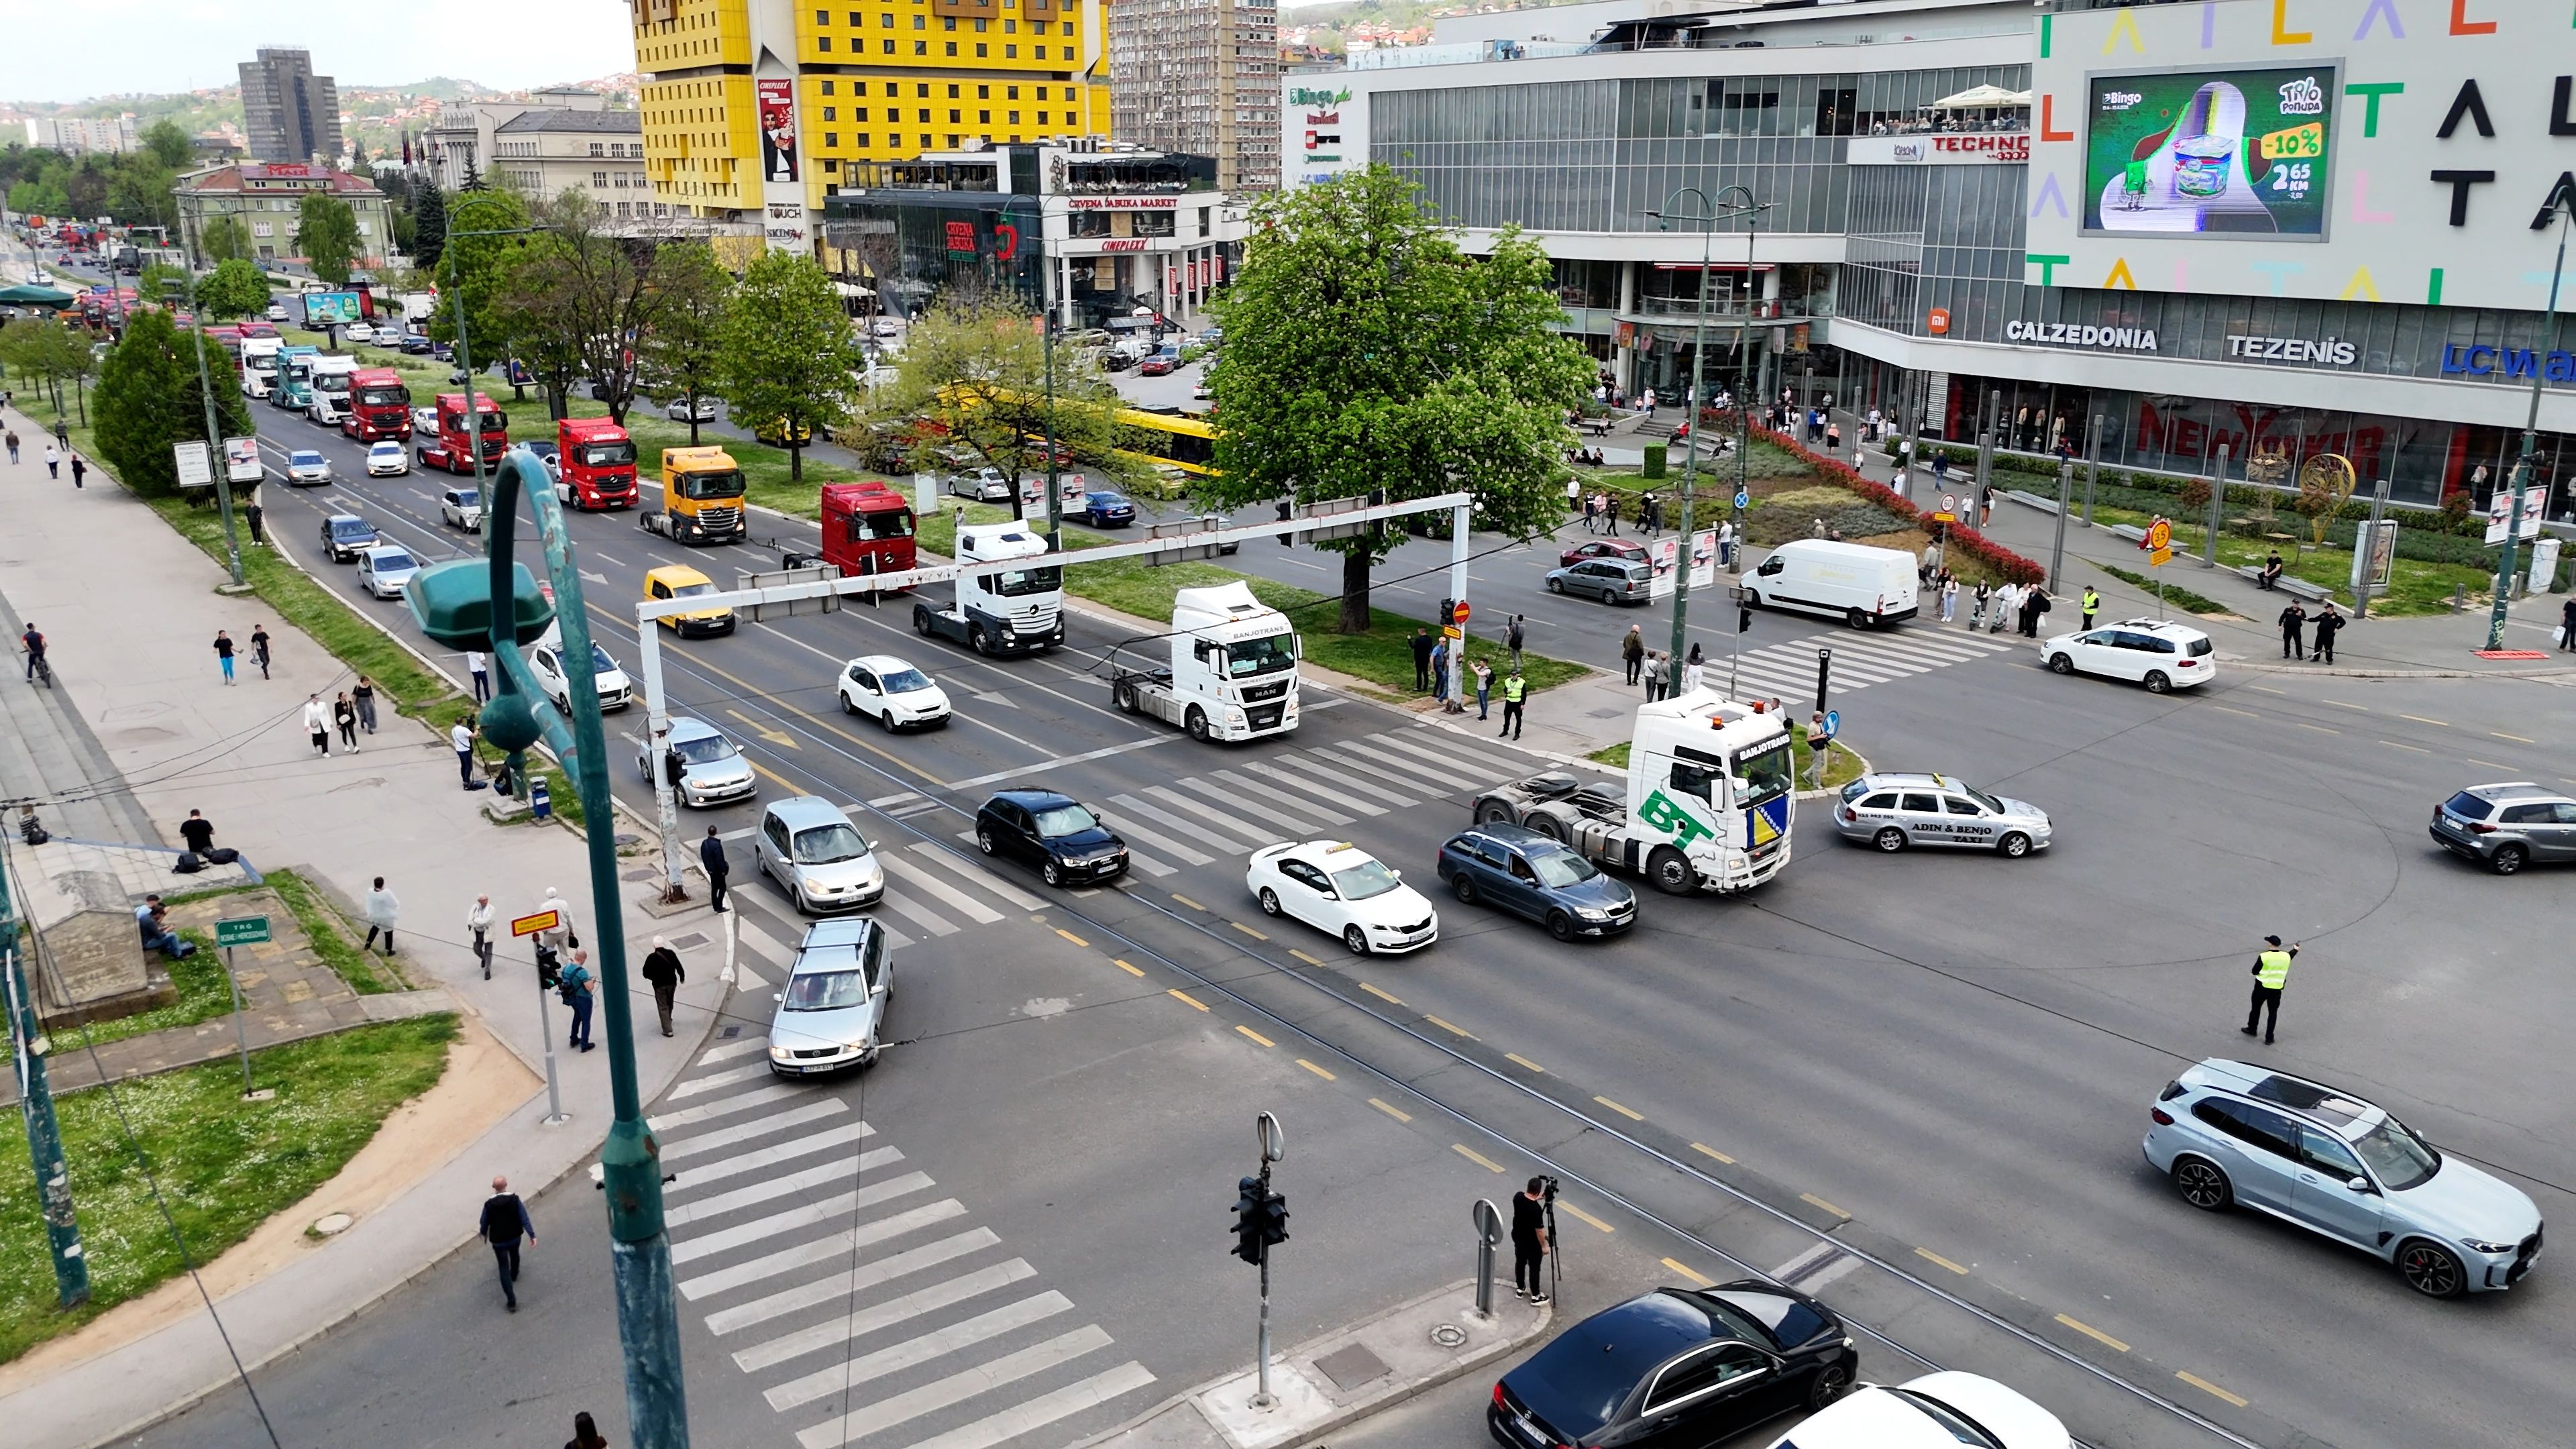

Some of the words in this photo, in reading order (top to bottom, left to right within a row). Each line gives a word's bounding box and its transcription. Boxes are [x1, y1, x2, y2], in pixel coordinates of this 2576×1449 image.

[1297, 87, 1334, 109] Bingo
[2110, 91, 2142, 105] Bingo
[2265, 128, 2318, 155] -10%
[2290, 163, 2310, 180] 65
[2289, 180, 2309, 191] KM
[1069, 199, 1102, 208] CRVENA
[1140, 199, 1177, 207] MARKET
[769, 208, 802, 219] TOUCH
[766, 228, 791, 237] SKIN
[946, 221, 975, 235] CRVENA
[1102, 237, 1148, 252] CINEPLEXX
[2006, 320, 2157, 350] CALZEDONIA
[2442, 343, 2493, 375] LC
[1234, 625, 1284, 639] BANJOTRANS
[1255, 688, 1277, 698] MAN
[1739, 733, 1790, 761] BANJOTRANS
[1637, 789, 1715, 851] BT
[1912, 822, 1942, 832] ADIN
[1945, 824, 1953, 833] &
[1953, 835, 1982, 844] TAXI
